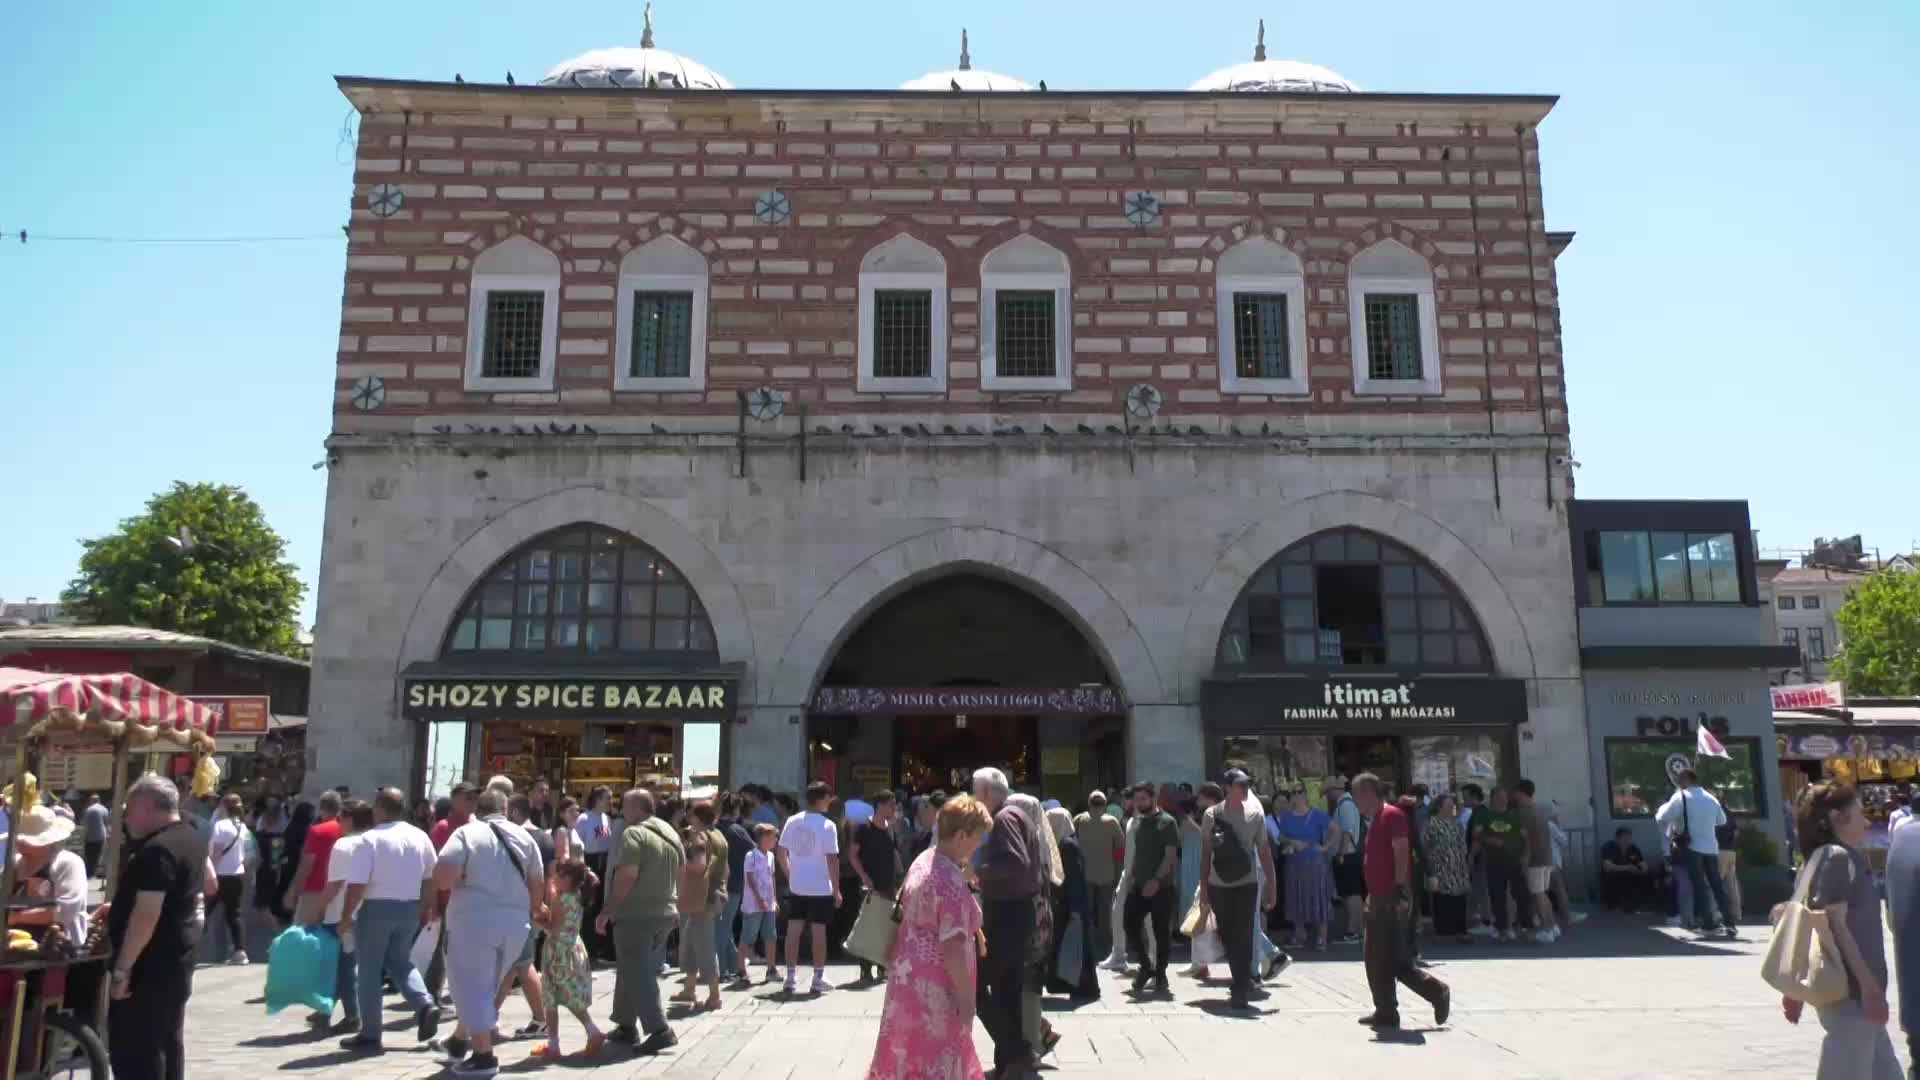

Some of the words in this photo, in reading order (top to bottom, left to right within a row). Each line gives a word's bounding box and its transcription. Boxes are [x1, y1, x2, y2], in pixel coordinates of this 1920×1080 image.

[409, 685, 508, 708] SHOZY
[516, 685, 595, 708] SPICE
[604, 685, 725, 709] BAZAAR
[1003, 694, 1044, 708] (1664)
[1324, 683, 1410, 704] itimat
[1284, 707, 1338, 719] FABRİKA
[1346, 707, 1383, 721] SATIŞ
